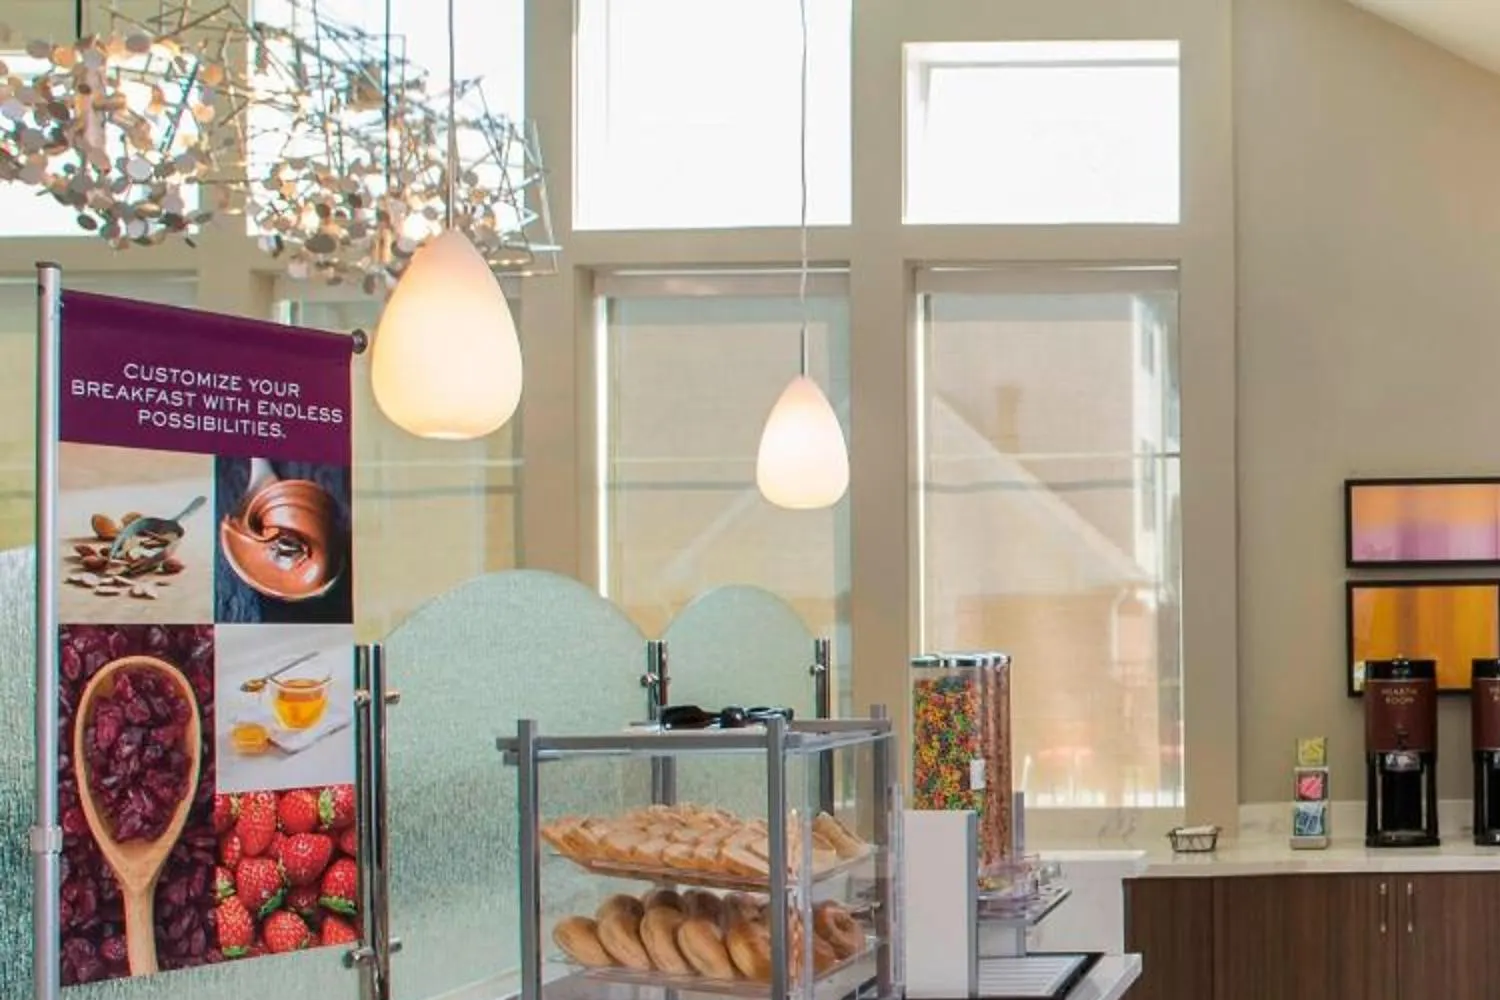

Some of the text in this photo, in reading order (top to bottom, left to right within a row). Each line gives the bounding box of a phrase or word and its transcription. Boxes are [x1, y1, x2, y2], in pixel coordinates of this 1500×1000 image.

[123, 363, 301, 398] CUSTOMIZE YOUR
[71, 379, 343, 424] BREAKFAST WITH ENDLESS
[138, 410, 286, 438] POSSIBILITIES.
